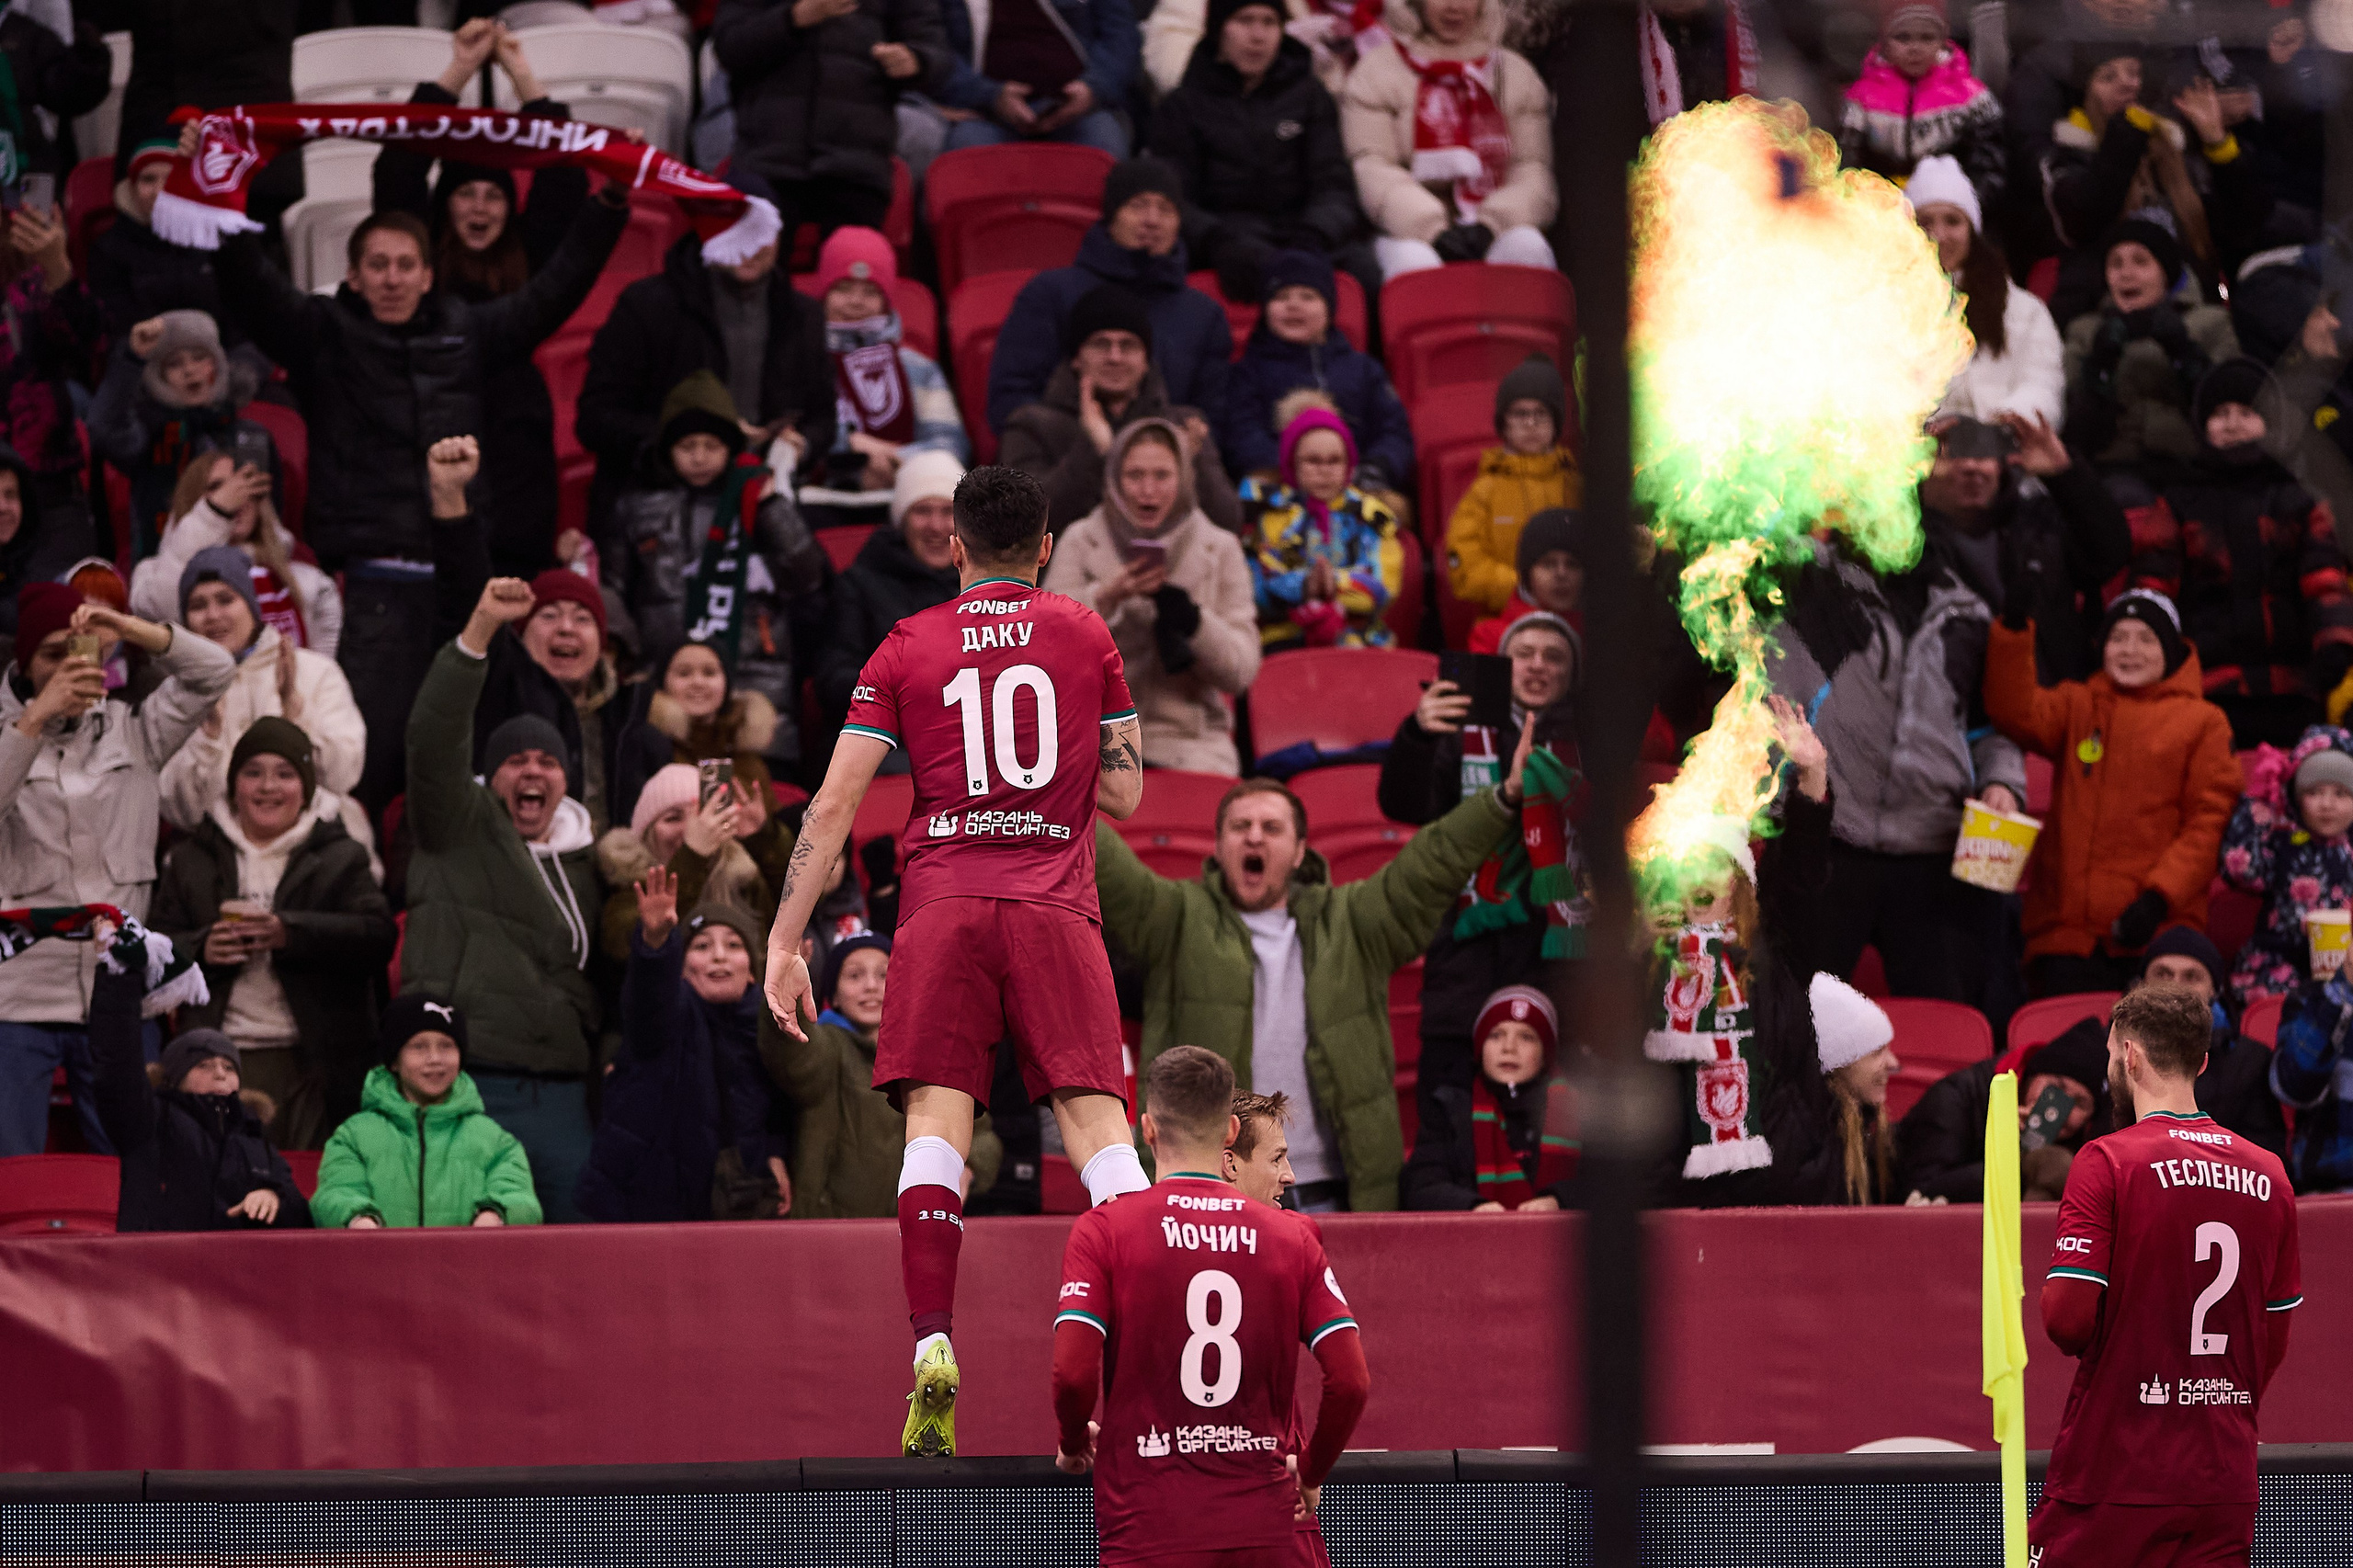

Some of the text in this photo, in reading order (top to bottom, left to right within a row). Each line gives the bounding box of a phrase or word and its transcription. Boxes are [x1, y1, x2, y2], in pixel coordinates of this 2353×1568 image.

[956, 599, 1031, 615] FONBET
[961, 621, 1034, 653] ДАКУ
[942, 664, 1059, 797] 10
[966, 811, 1044, 824] КАЗАНЬ
[964, 822, 1072, 839] ОРГСИНТЕЗ
[2168, 1129, 2233, 1145] FONBET
[2150, 1158, 2271, 1202] ТЕСЛЕНКО
[1166, 1194, 1246, 1211] FONBET
[1160, 1215, 1257, 1256] ЙОЧИЧ
[1058, 1281, 1091, 1302] ОС
[2189, 1221, 2241, 1356] 2
[1179, 1269, 1243, 1408] 8
[2178, 1378, 2234, 1392] КАЗАНЬ
[1176, 1425, 1252, 1440] КАЗАНЬ
[1176, 1436, 1278, 1453] ОРГСИНТЕЗ
